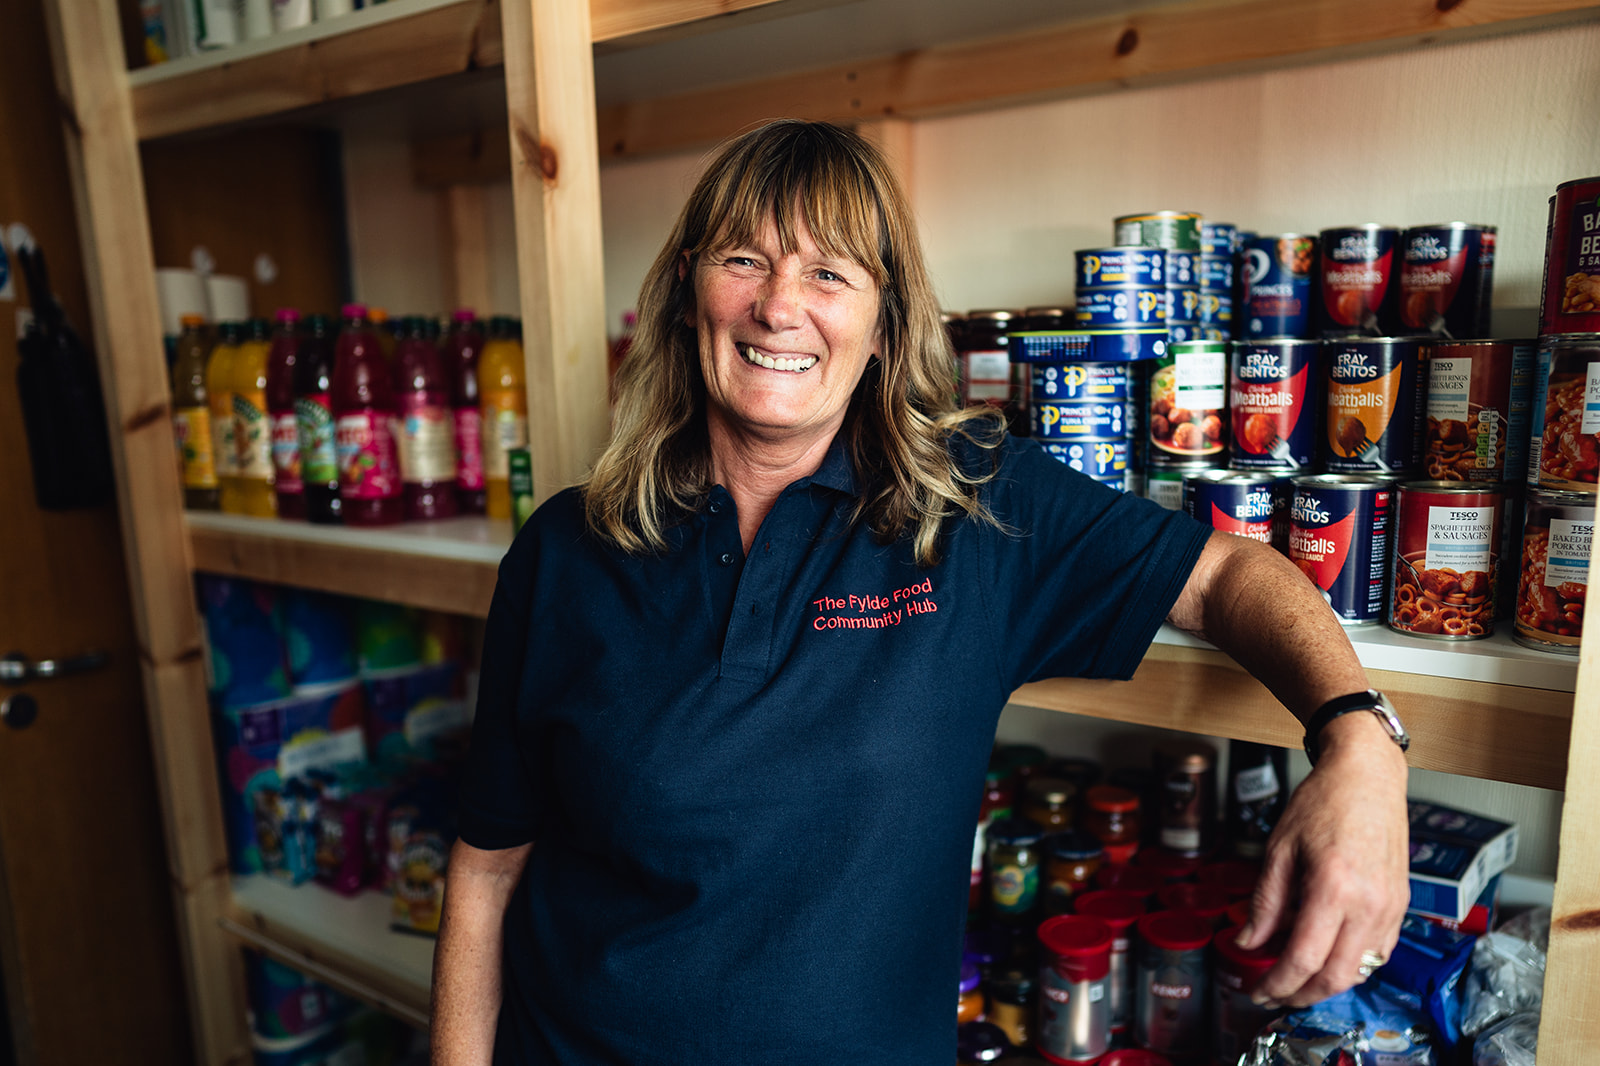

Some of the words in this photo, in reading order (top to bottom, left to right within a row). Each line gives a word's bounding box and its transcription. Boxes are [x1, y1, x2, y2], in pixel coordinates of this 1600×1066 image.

[1411, 237, 1440, 248] FRAY
[1333, 248, 1379, 260] BENTOS
[1405, 247, 1448, 260] BENTOS
[1246, 353, 1279, 366] FRAY
[1337, 353, 1369, 366] FRAY
[1087, 367, 1115, 377] PRINCES
[1240, 364, 1288, 378] BENTOS
[1332, 364, 1378, 378] BENTOS
[1234, 391, 1294, 407] Meatballs
[1329, 392, 1384, 407] Meatballs
[1060, 407, 1092, 416] PRINCES
[1245, 492, 1272, 506] FRAY
[1294, 497, 1321, 510] FRAY
[1442, 532, 1488, 540] SAUSAGES
[1553, 534, 1582, 543] BAKED
[1290, 538, 1336, 554] eatballs
[1552, 542, 1575, 551] PORK
[1305, 553, 1325, 562] SAUCE
[813, 596, 846, 612] The
[849, 594, 890, 613] Fylde
[893, 577, 933, 603] Food
[813, 609, 902, 631] Community
[906, 598, 938, 617] Hub
